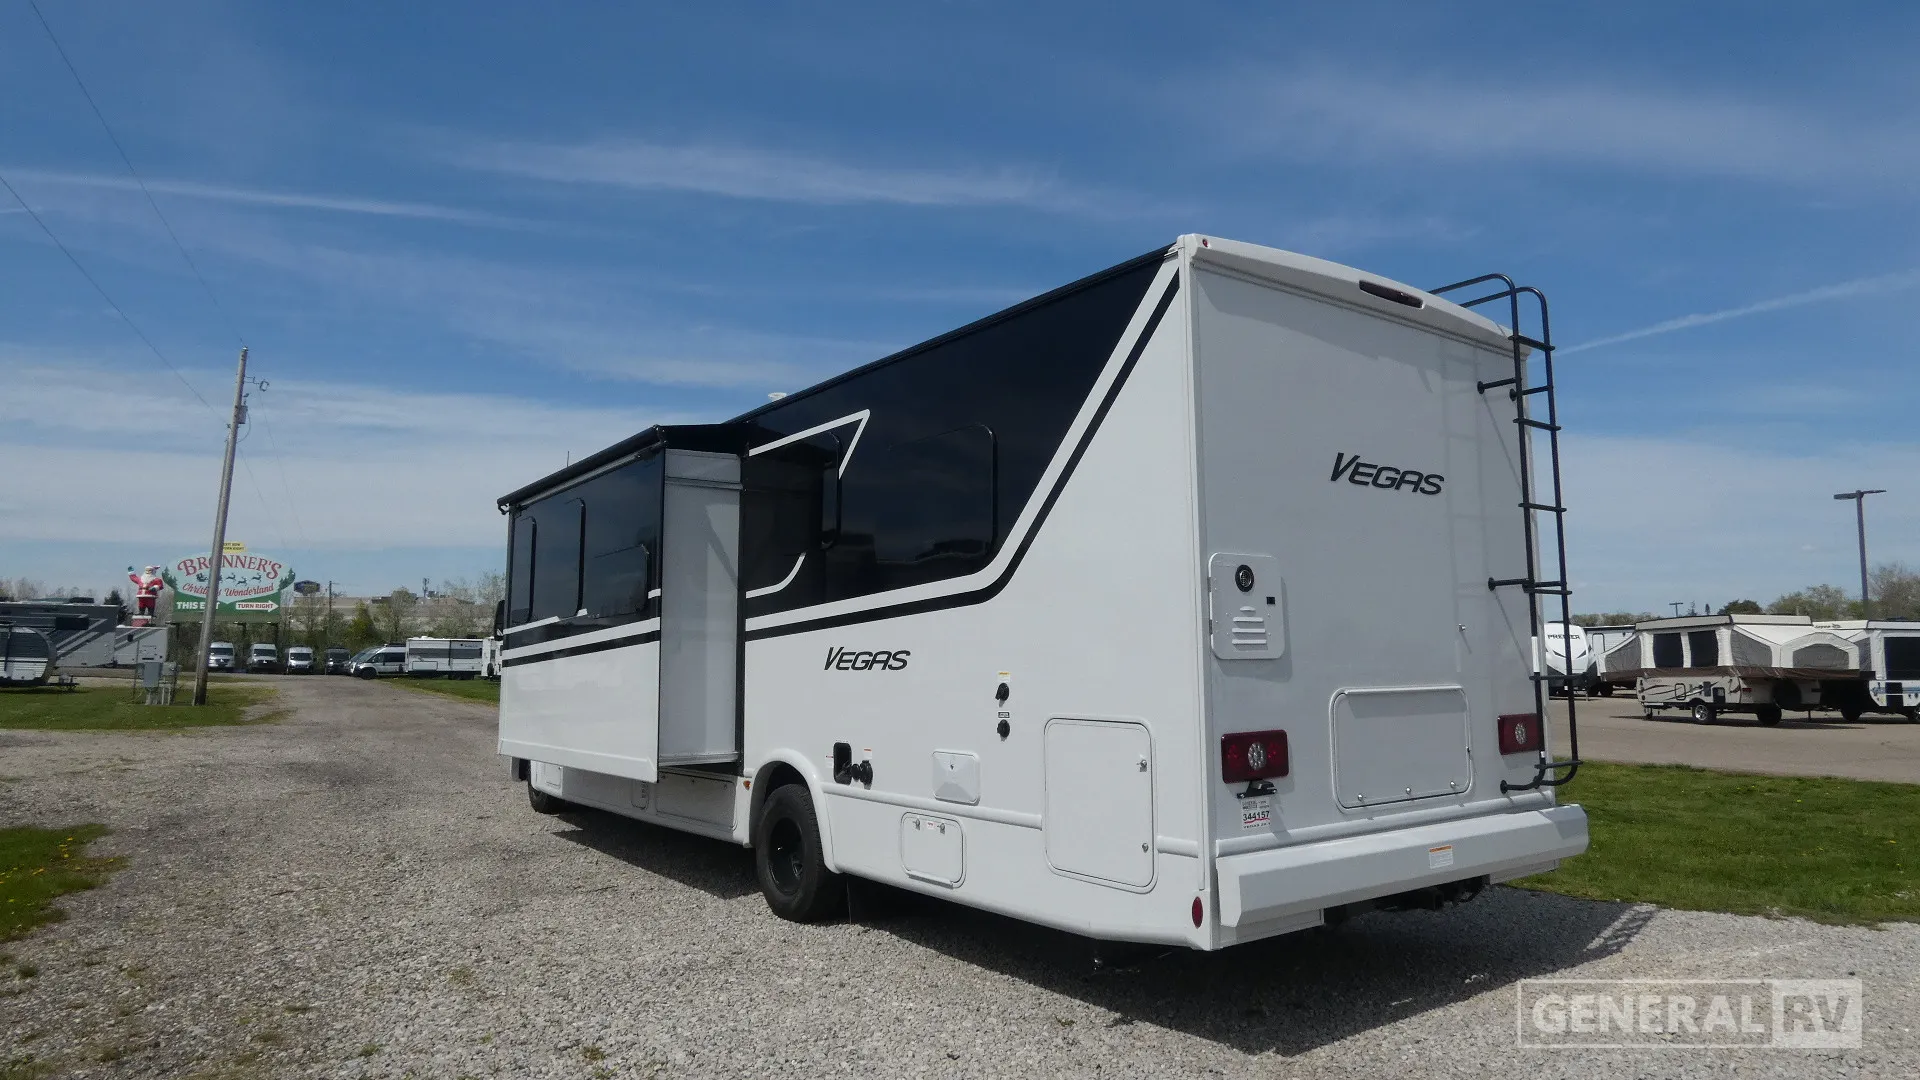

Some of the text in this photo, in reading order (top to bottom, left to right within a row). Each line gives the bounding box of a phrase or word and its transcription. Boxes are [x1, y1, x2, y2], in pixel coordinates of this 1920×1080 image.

[1331, 452, 1445, 496] VEGAS
[177, 554, 282, 580] BRNNER'S
[224, 583, 274, 597] Wonderland
[176, 602, 220, 610] THIS ET
[824, 646, 911, 671] VEGAS
[1242, 810, 1270, 821] 344157
